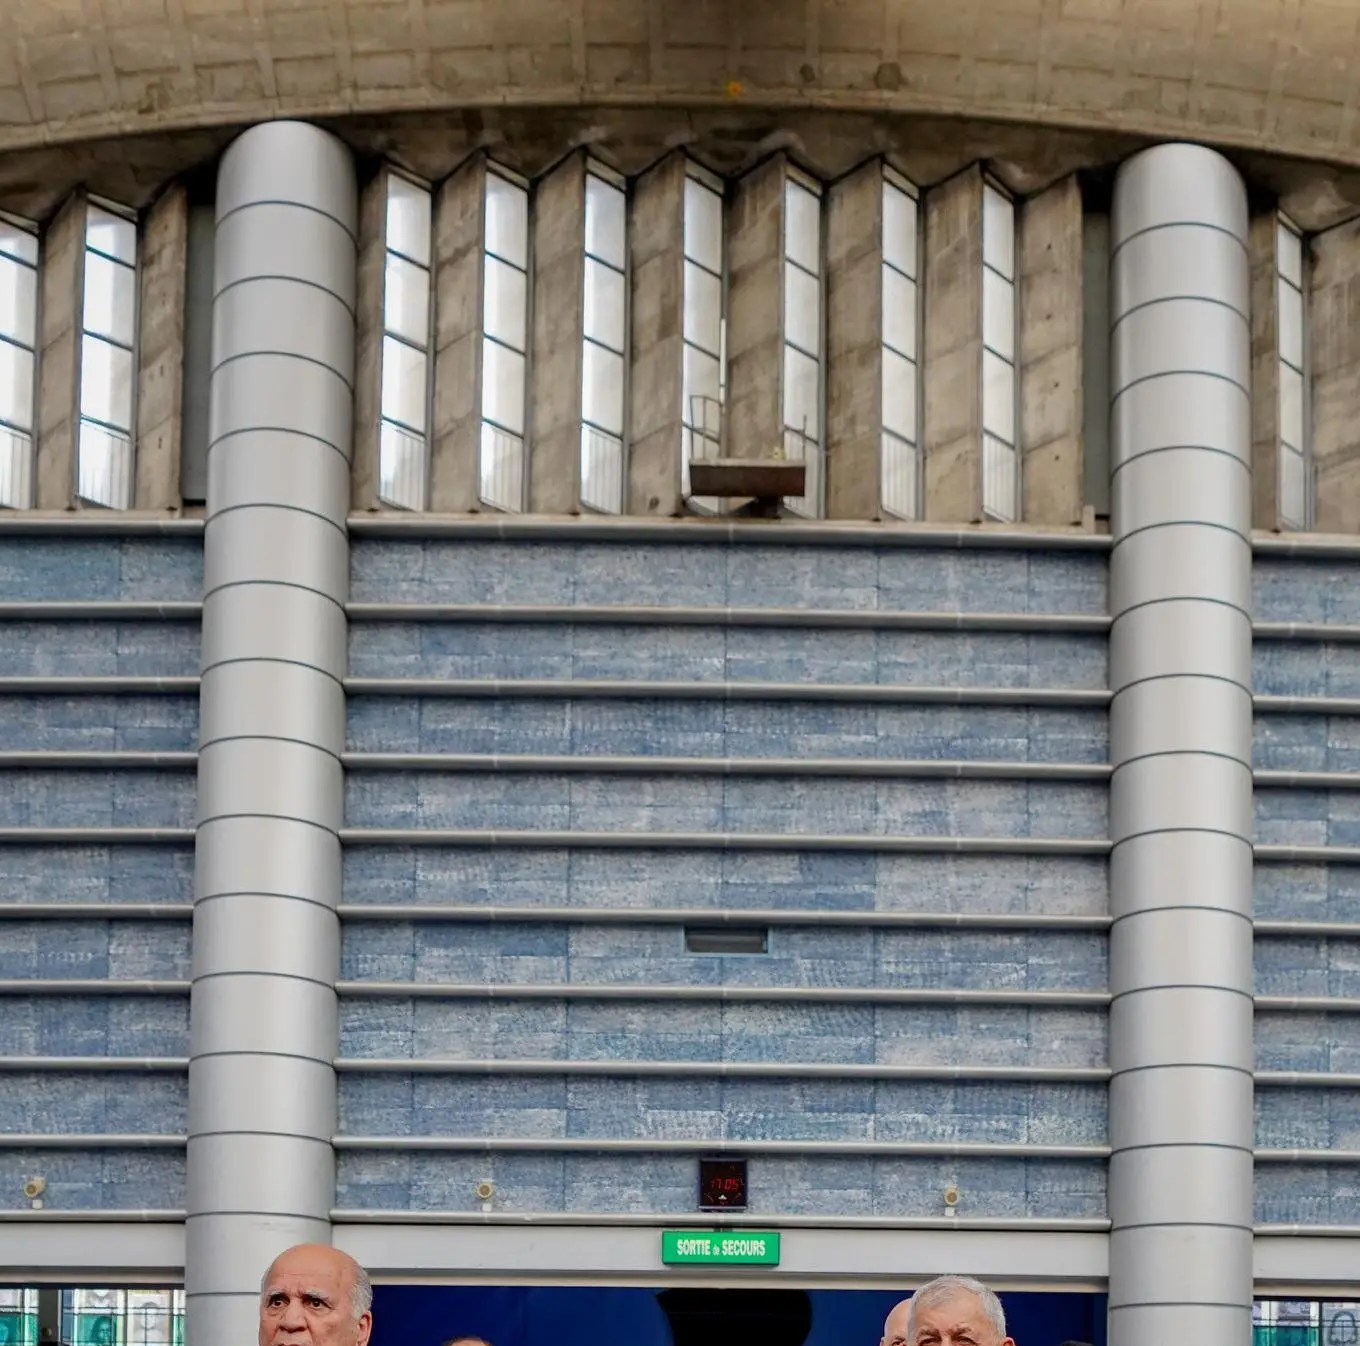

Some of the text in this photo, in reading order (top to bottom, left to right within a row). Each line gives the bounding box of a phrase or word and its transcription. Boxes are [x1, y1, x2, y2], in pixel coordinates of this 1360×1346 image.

[677, 1239, 766, 1256] SORTIE de SECOURS
